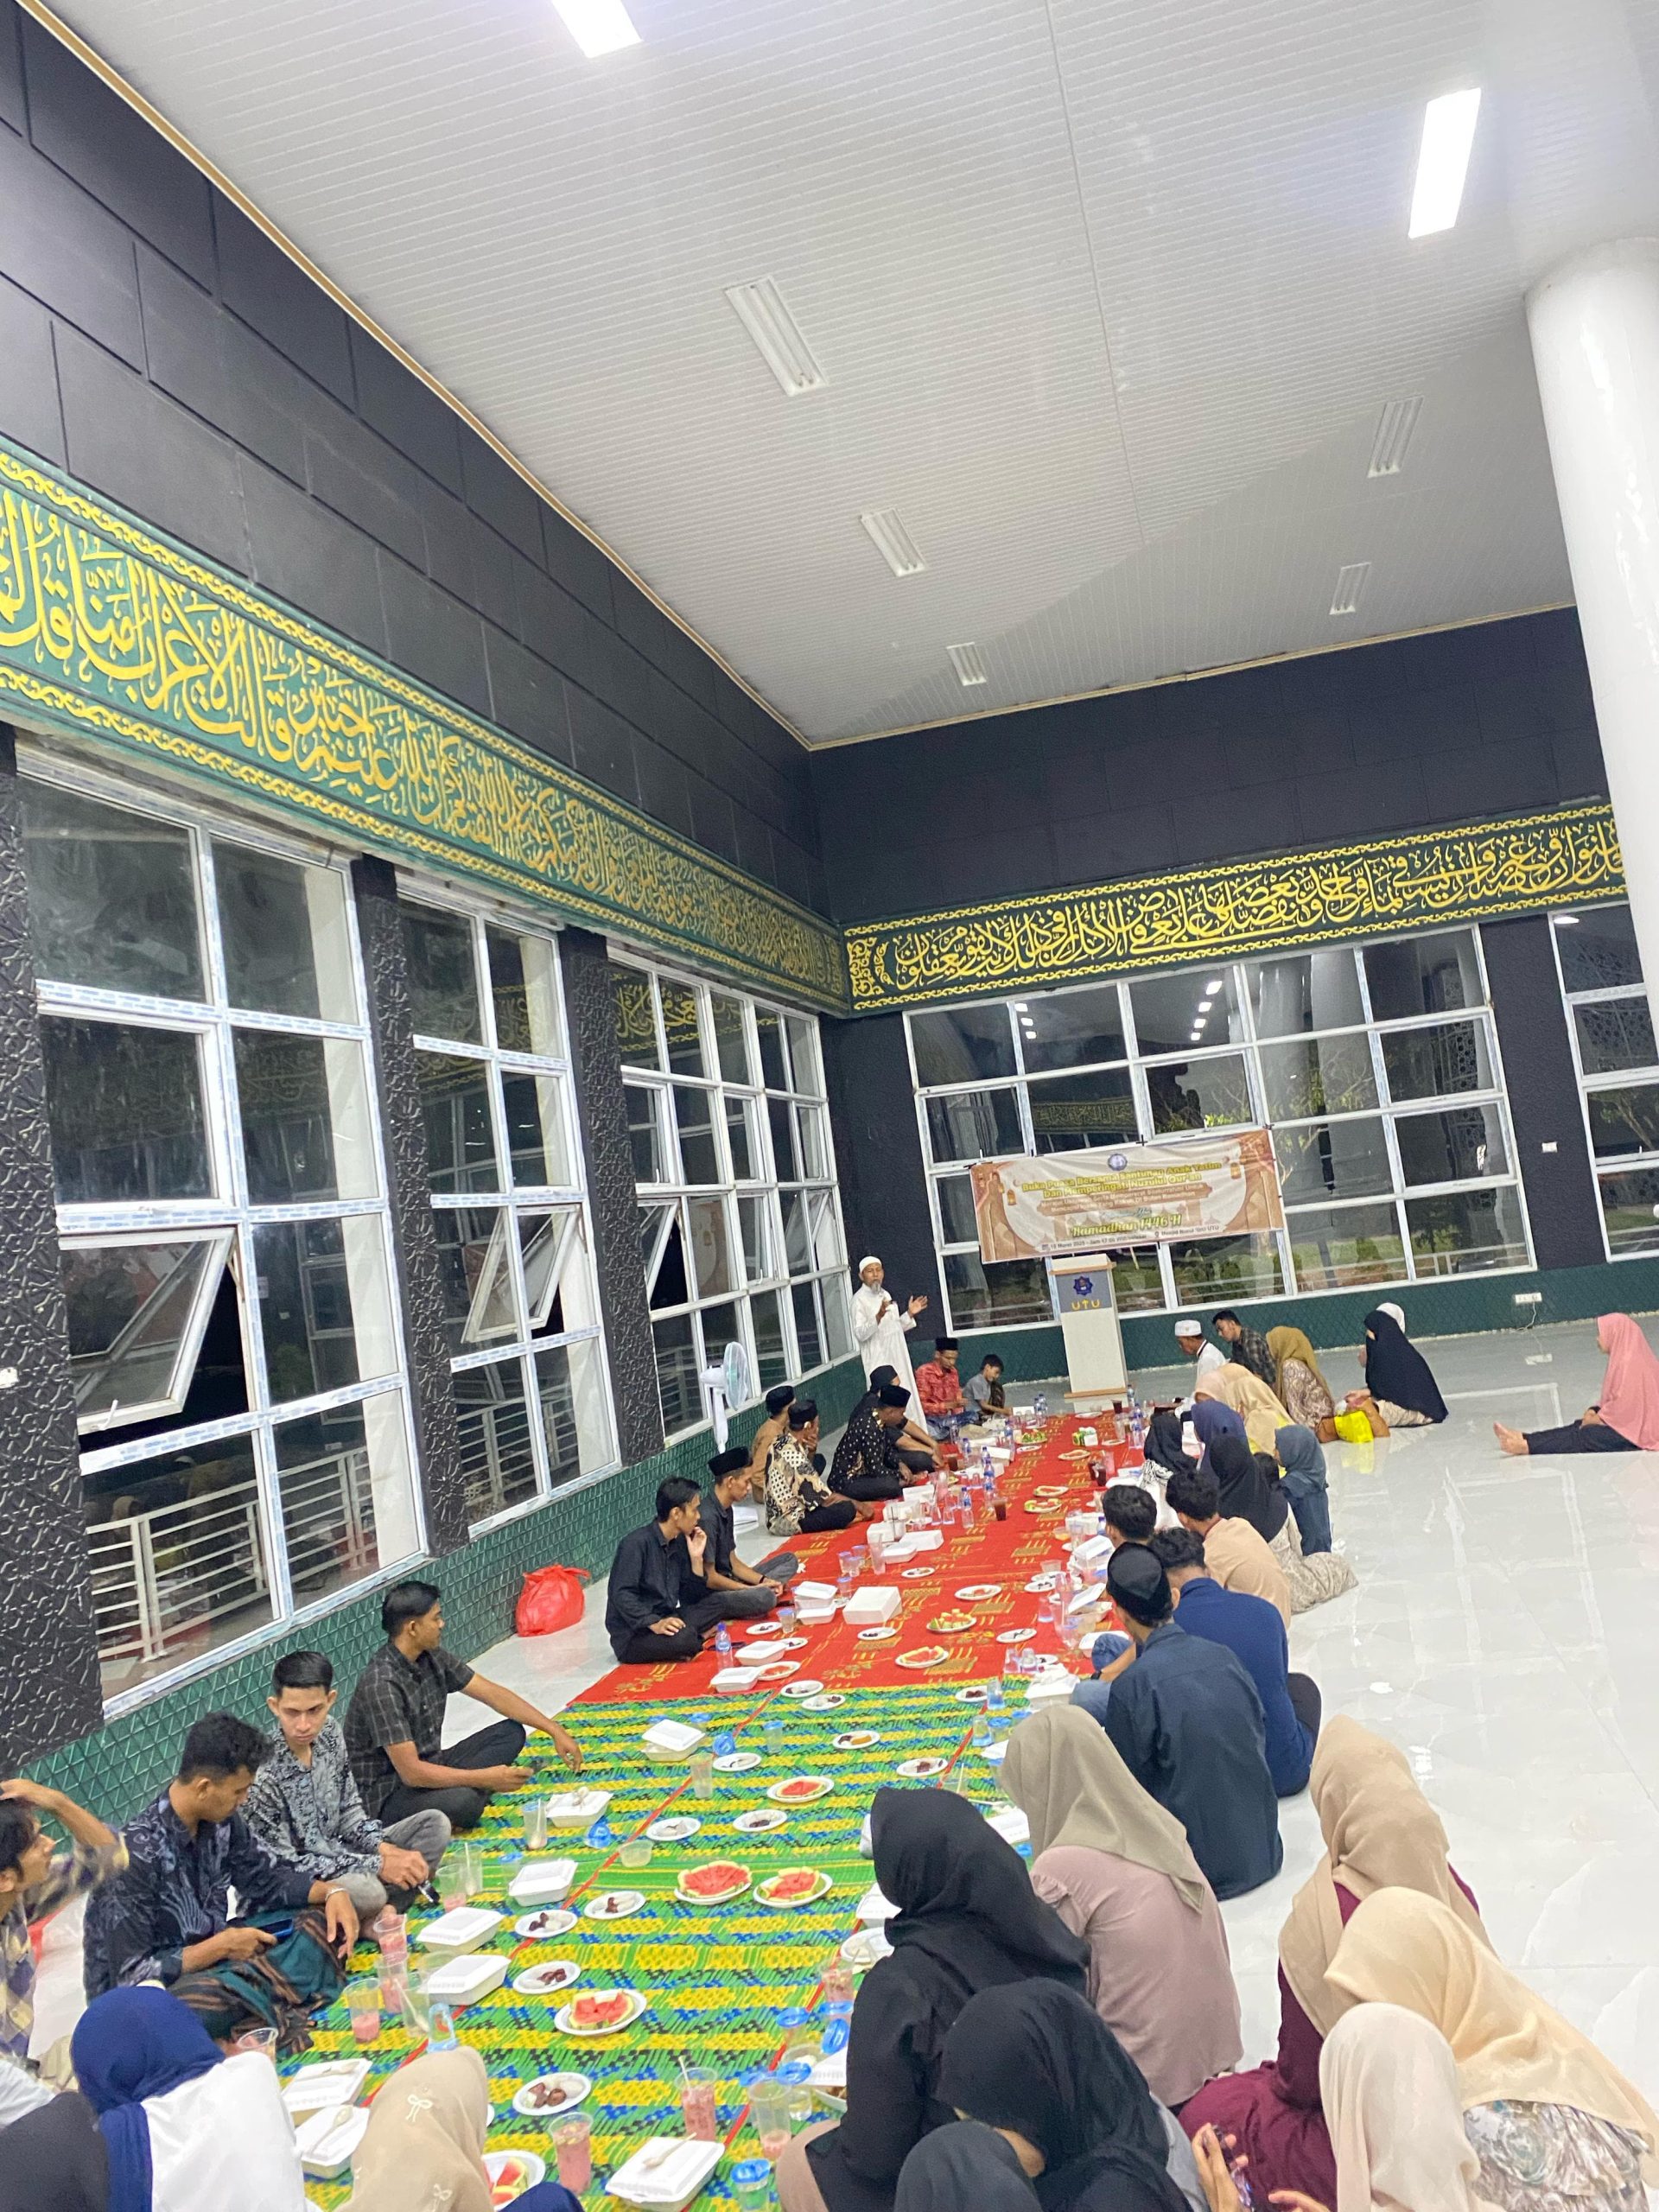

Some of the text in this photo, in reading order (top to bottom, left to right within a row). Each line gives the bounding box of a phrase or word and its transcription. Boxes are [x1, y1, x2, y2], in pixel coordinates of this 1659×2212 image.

[1022, 1162, 1222, 1192] Buka Puasa Bersama Santunan Anak Yatim
[1043, 1189, 1063, 1198] Dan
[1064, 1180, 1130, 1197] Memperingati
[1130, 1177, 1167, 1188] Nuzulul
[1071, 1221, 1140, 1237] Ramadhan
[1140, 1216, 1168, 1231] 1446
[1071, 1298, 1100, 1310] UTU
